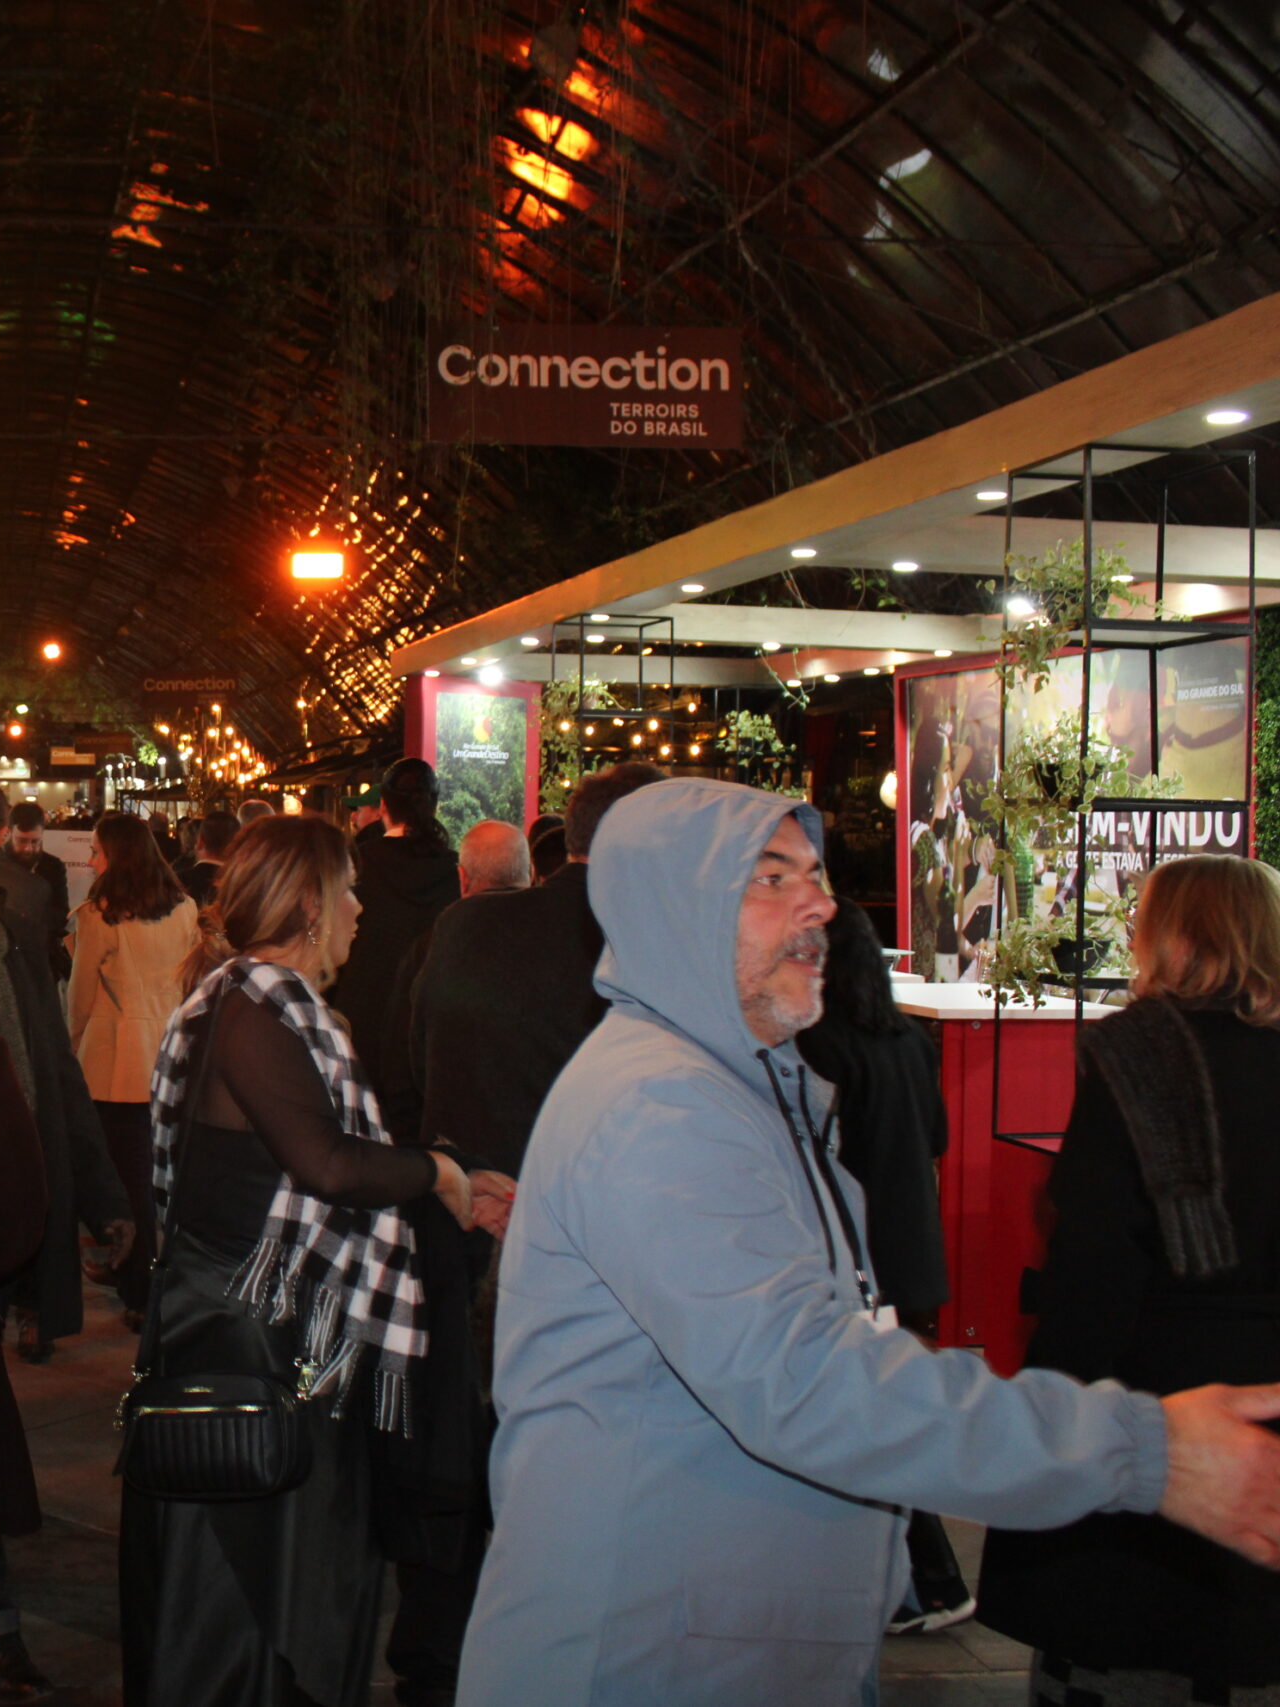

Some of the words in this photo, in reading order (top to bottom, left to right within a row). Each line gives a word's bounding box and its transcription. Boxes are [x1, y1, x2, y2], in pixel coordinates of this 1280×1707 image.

[437, 344, 731, 392] Connection
[609, 402, 700, 418] TERROIRS
[609, 419, 638, 435] DO
[643, 420, 709, 436] BRASIL
[143, 677, 236, 691] Connection
[1219, 684, 1230, 697] DO
[1231, 683, 1245, 695] SUL
[1102, 852, 1144, 872] ESTAVA
